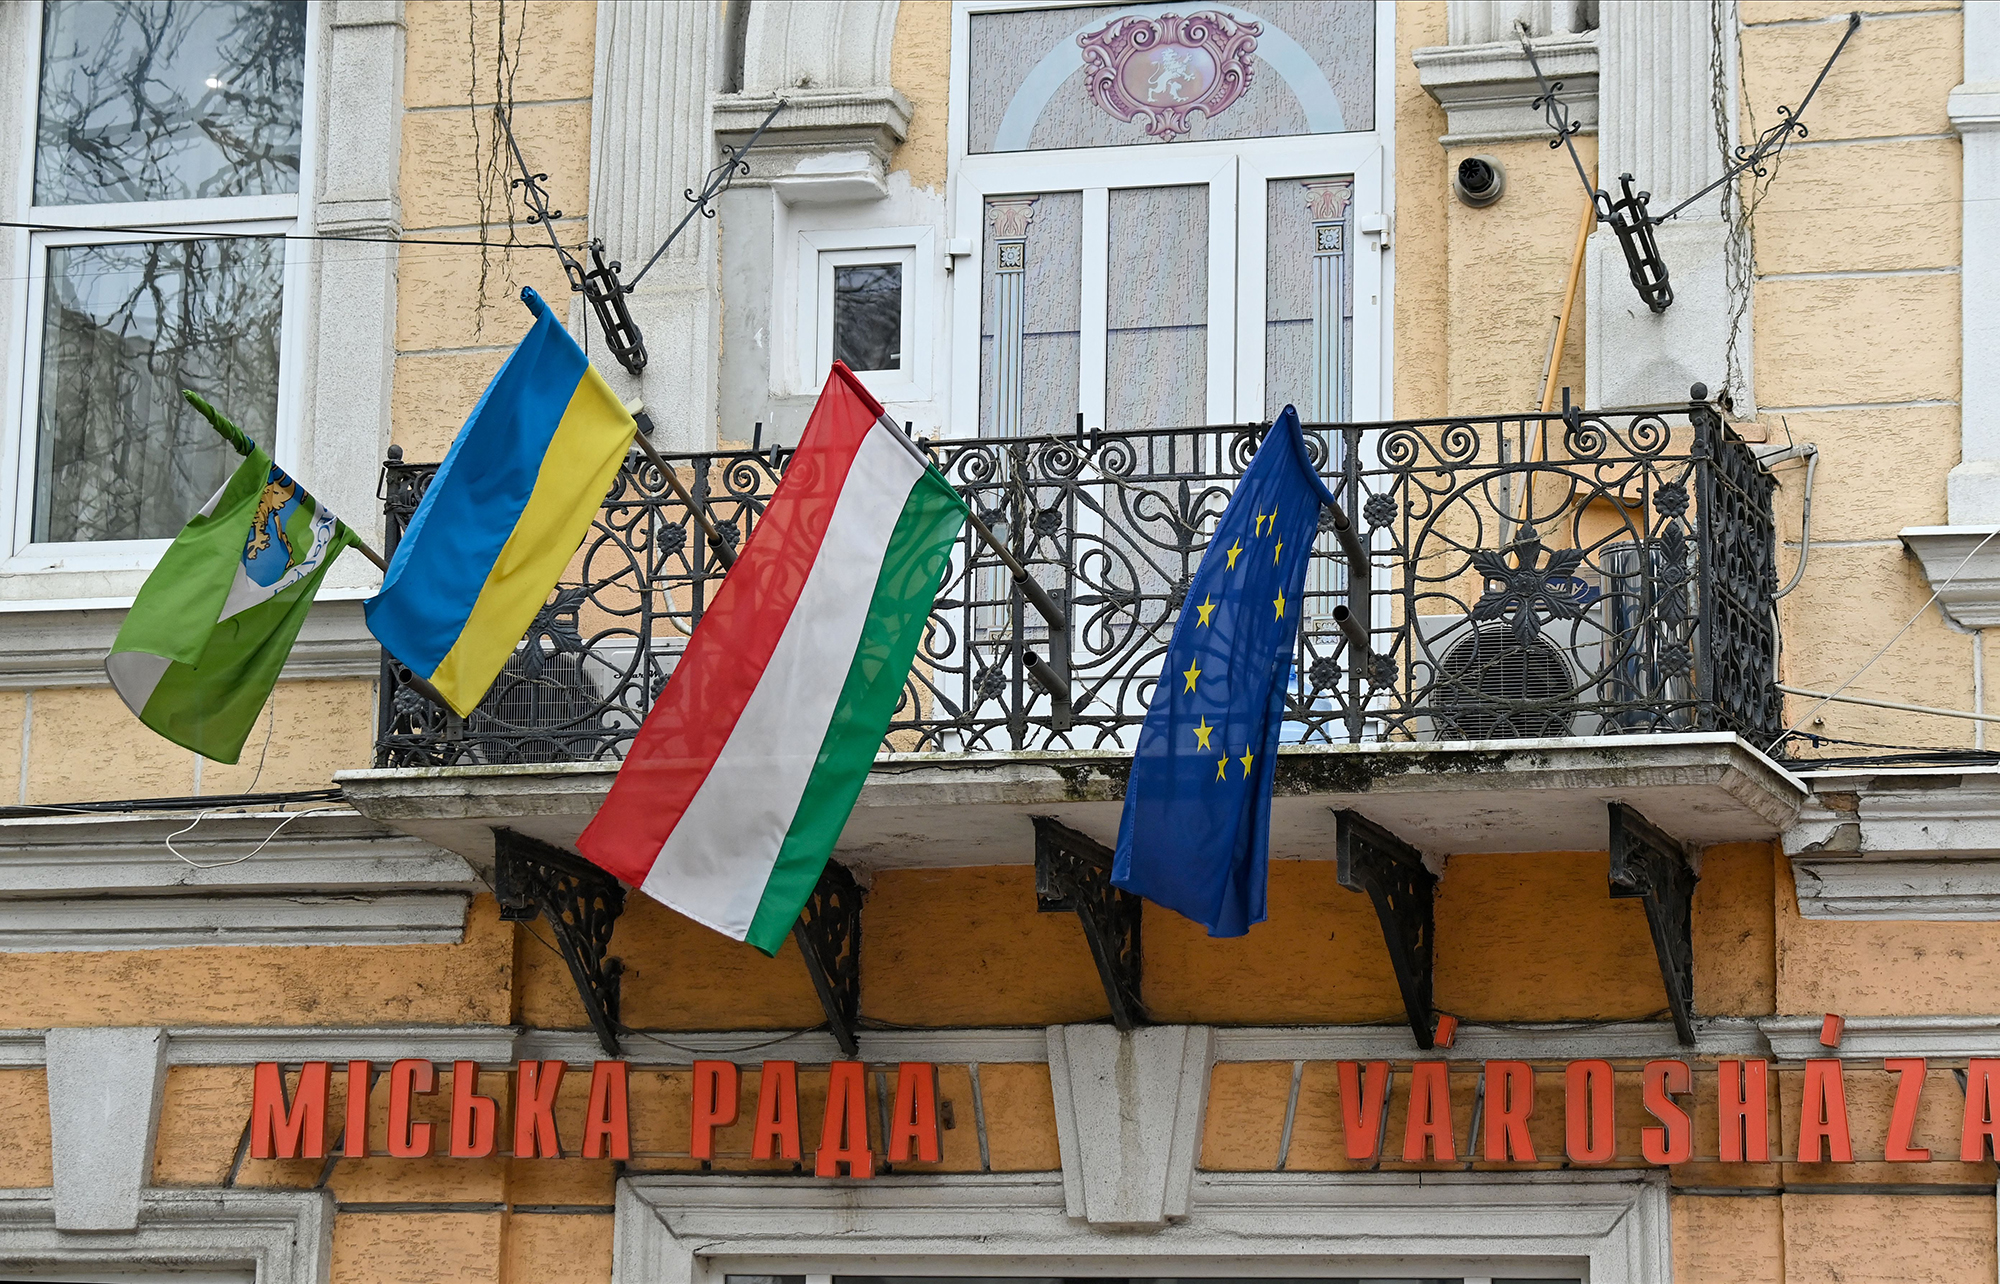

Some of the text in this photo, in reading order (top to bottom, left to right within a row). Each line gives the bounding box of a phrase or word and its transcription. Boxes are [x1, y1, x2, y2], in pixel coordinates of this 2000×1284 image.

[250, 1058, 943, 1179] МІСЬКА РАДА
[1336, 1013, 2000, 1164] VÁROSHÁZA
